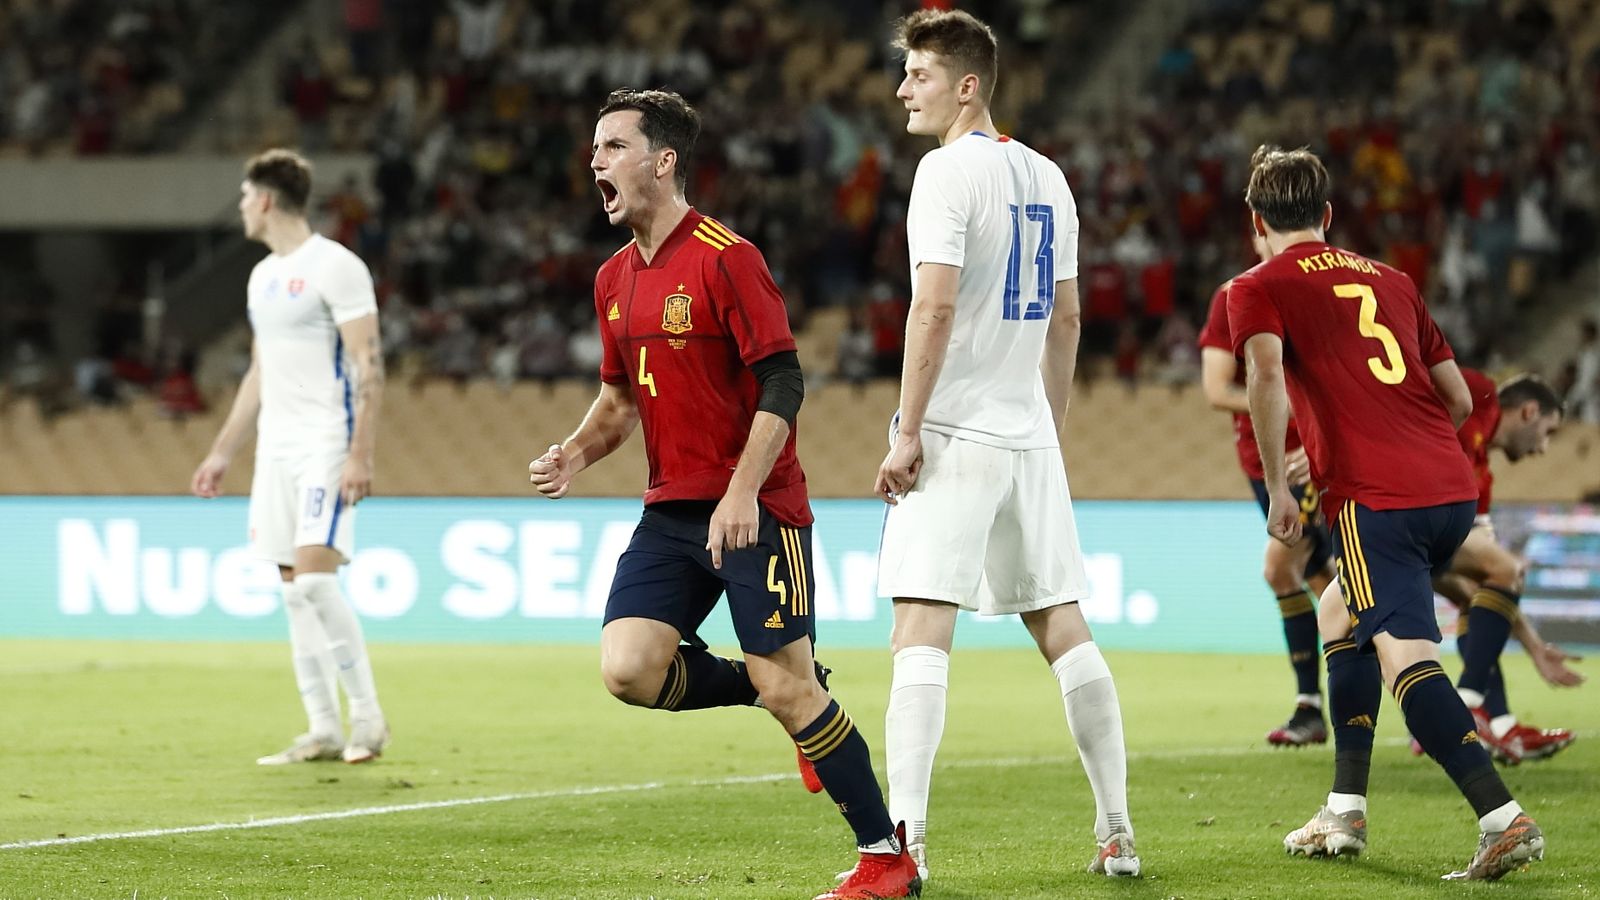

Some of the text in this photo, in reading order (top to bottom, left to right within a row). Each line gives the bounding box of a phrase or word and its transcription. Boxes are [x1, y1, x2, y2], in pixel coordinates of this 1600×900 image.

[1002, 204, 1055, 320] 13
[1297, 252, 1381, 276] MIRANDA
[1333, 283, 1407, 385] 3
[638, 346, 657, 397] 4
[304, 487, 326, 518] 18
[57, 517, 419, 618] Nueo
[767, 555, 786, 605] 4
